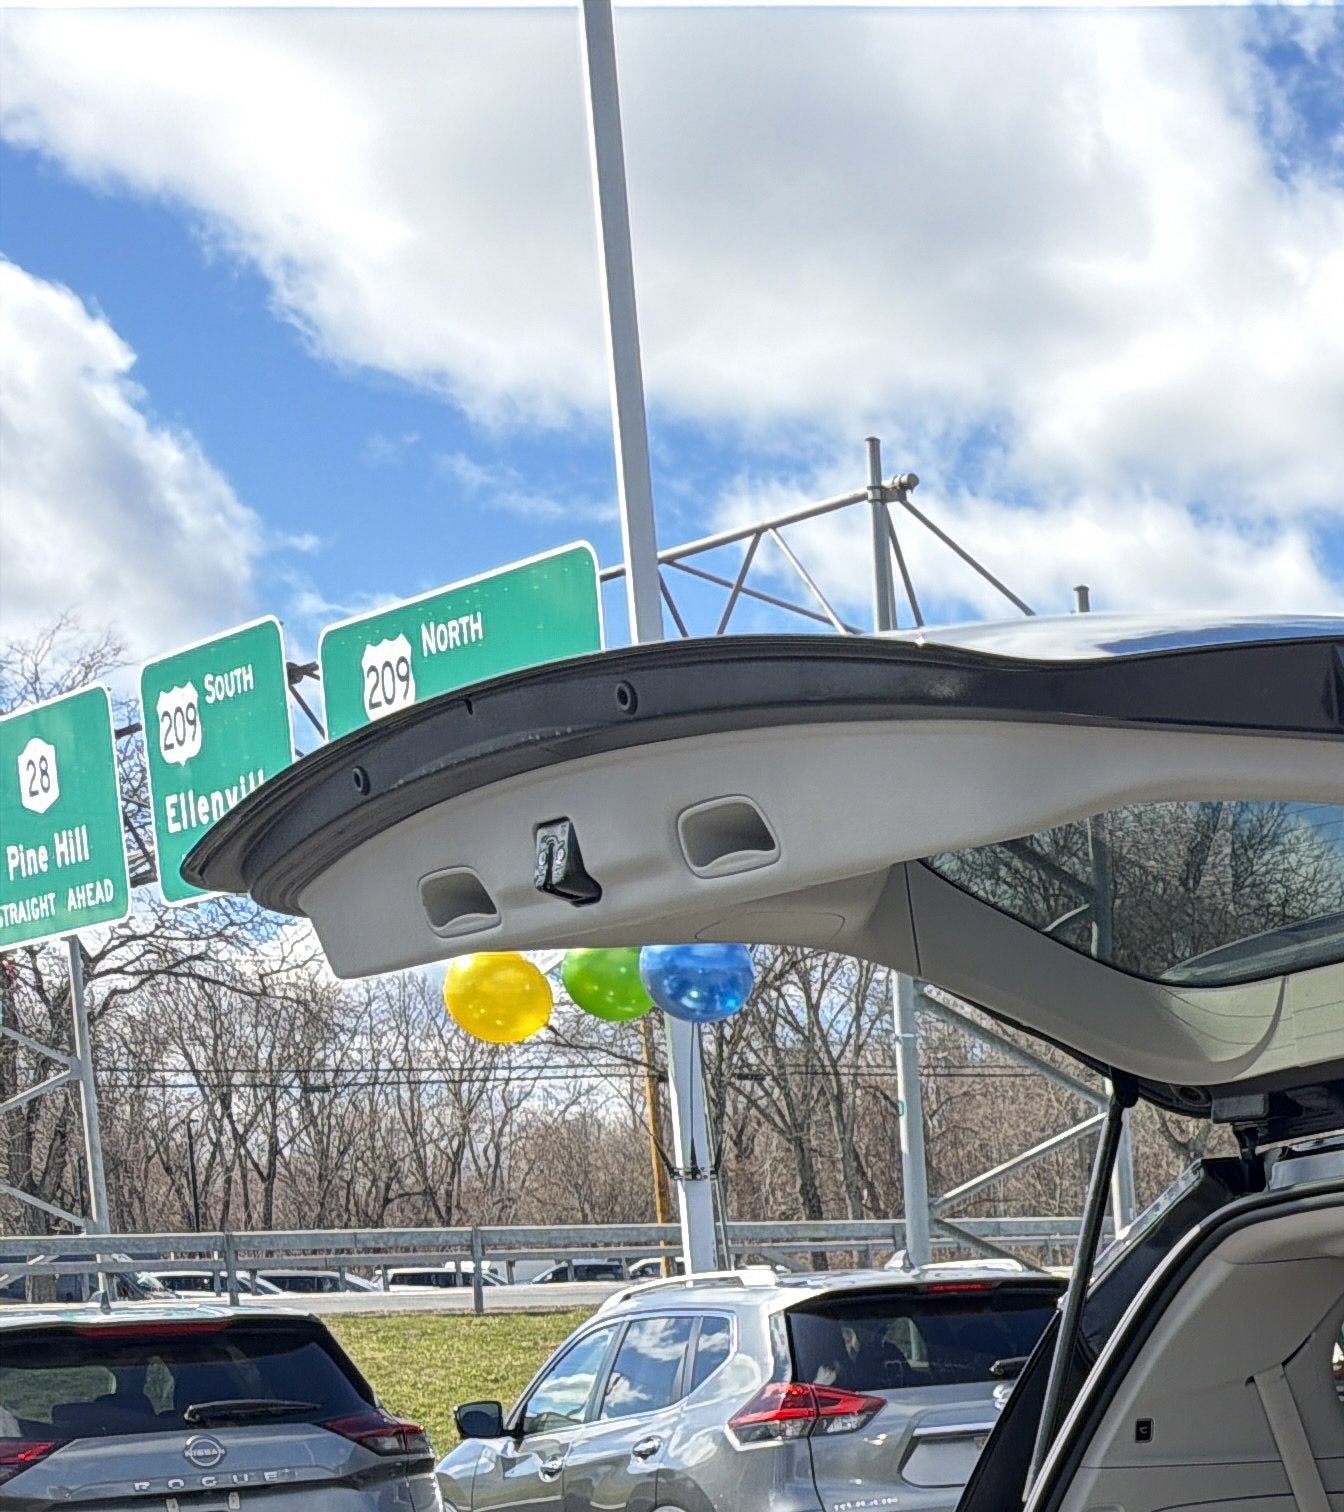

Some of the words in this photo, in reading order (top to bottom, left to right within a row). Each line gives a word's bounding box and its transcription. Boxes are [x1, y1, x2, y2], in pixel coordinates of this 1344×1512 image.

[421, 611, 483, 658] NORTH
[204, 664, 254, 704] SOUTH
[366, 656, 410, 710] 209
[160, 702, 198, 752] 209
[26, 755, 50, 797] 28
[165, 769, 264, 834] Ellenvil
[6, 844, 48, 881] Pine
[54, 825, 90, 868] Hill
[67, 879, 114, 912] AHEAD
[133, 1471, 279, 1492] ROGUE
